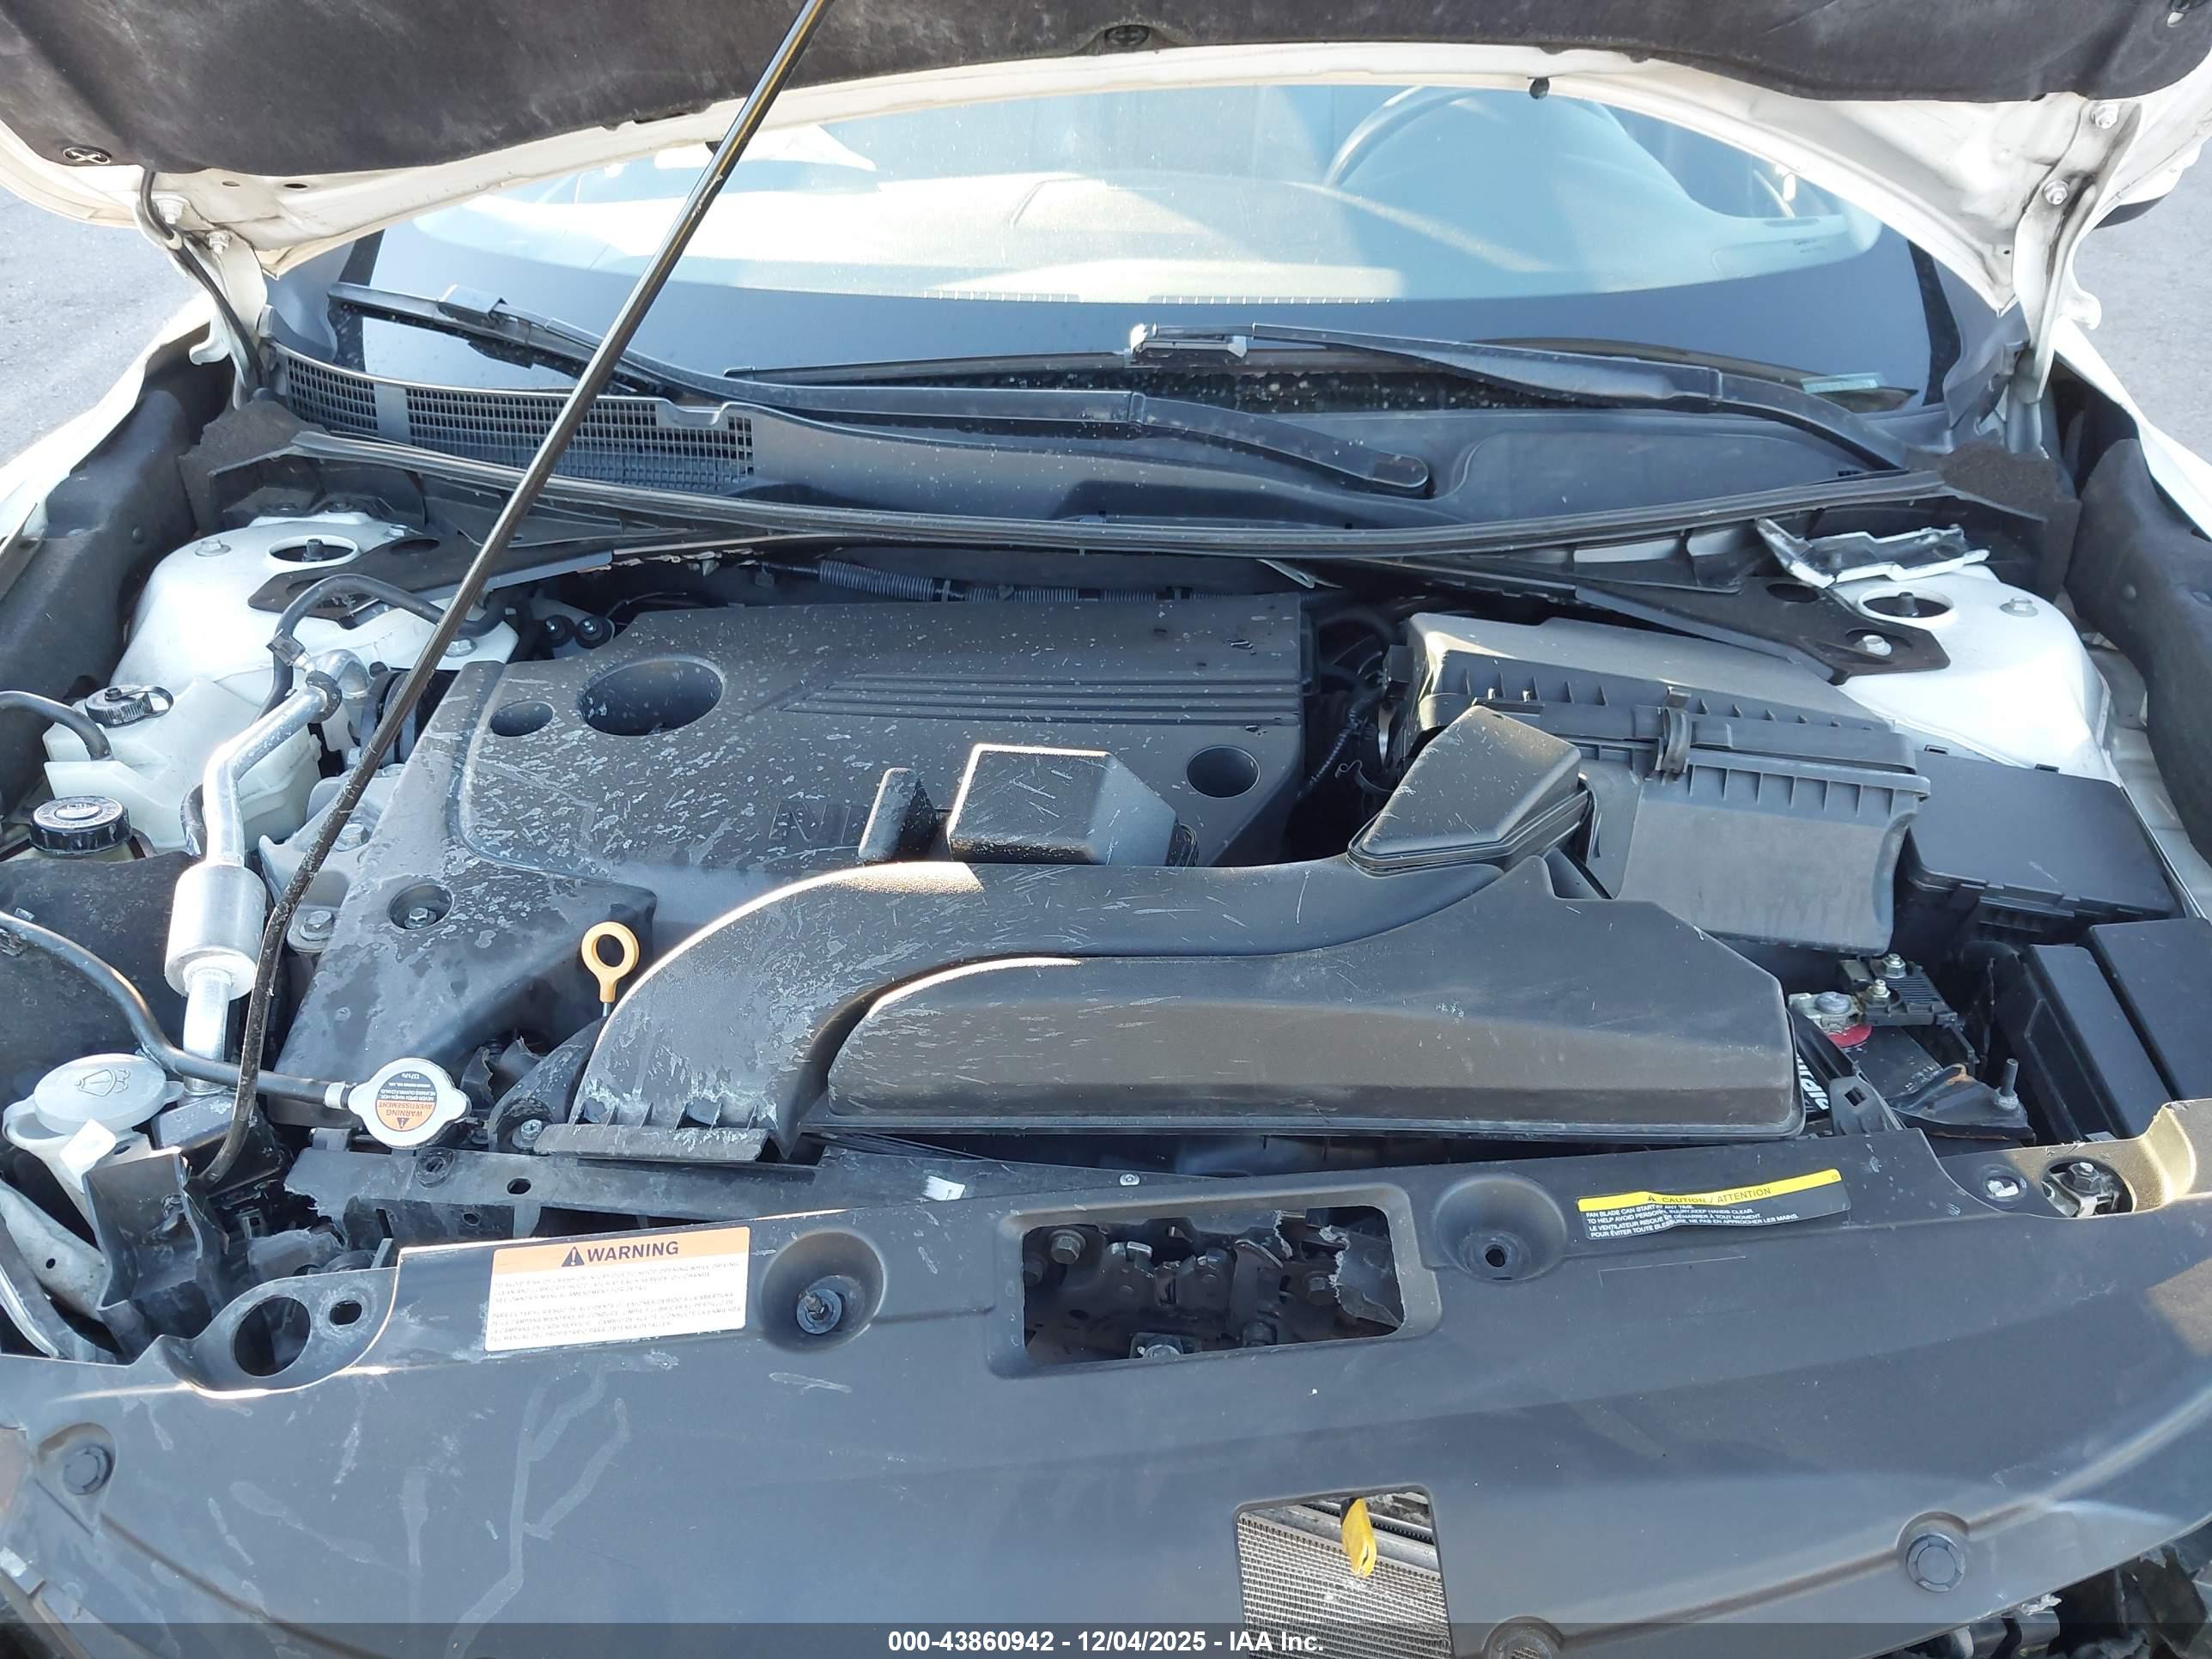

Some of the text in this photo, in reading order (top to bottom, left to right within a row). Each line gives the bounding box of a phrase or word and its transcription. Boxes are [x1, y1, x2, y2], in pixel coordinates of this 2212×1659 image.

[1717, 1188, 1771, 1203] ATTENTION
[1635, 1210, 1668, 1218] PERSONAL
[1598, 1221, 1638, 1231] VENTILATEUR
[587, 1241, 678, 1263] WARNING
